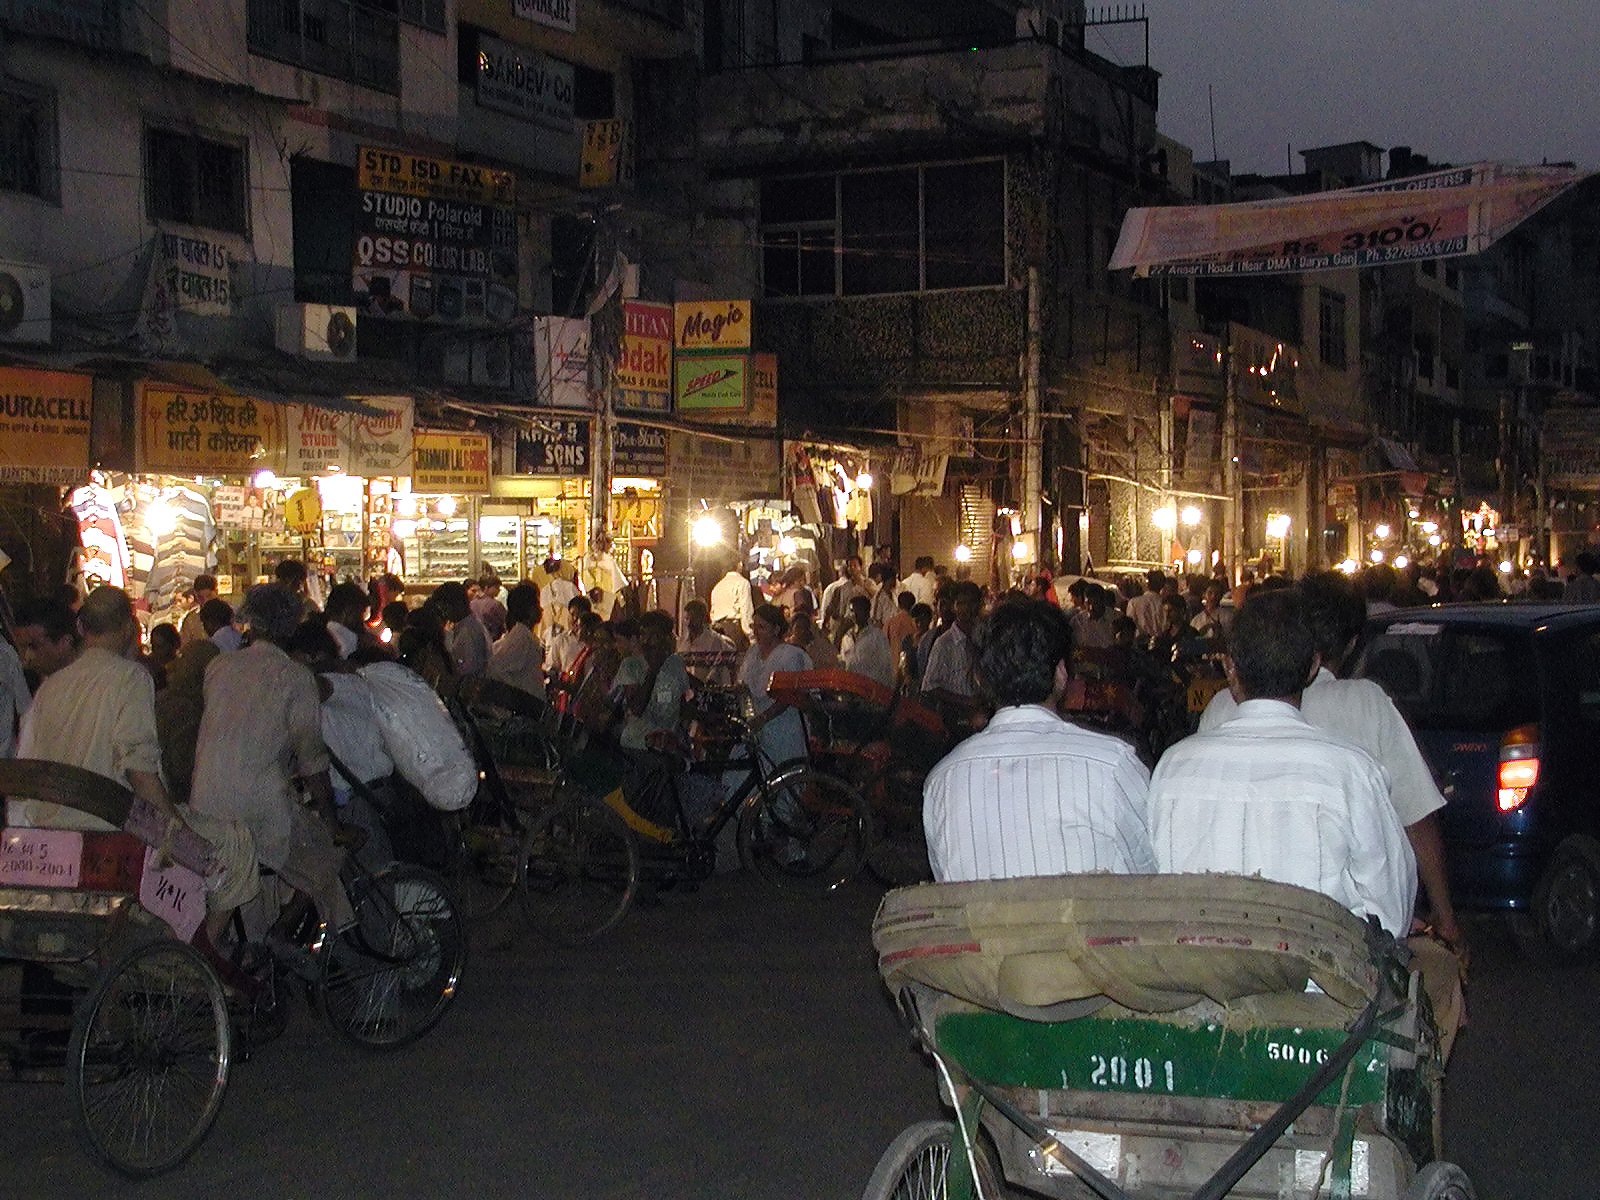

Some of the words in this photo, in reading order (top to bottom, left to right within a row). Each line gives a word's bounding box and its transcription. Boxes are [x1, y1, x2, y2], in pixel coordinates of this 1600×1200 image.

[366, 151, 402, 174] STD
[411, 159, 441, 181] ISD
[451, 166, 485, 188] FAX
[362, 192, 423, 219] STUDIO
[428, 200, 483, 227] Polaroid
[357, 235, 412, 267] QSS
[413, 242, 458, 270] COLOR
[682, 303, 744, 346] Magic
[618, 342, 669, 377] odak
[298, 405, 341, 432] Nice
[301, 432, 338, 447] STUDIO
[545, 444, 586, 467] SONS
[1090, 1055, 1174, 1091] 2001
